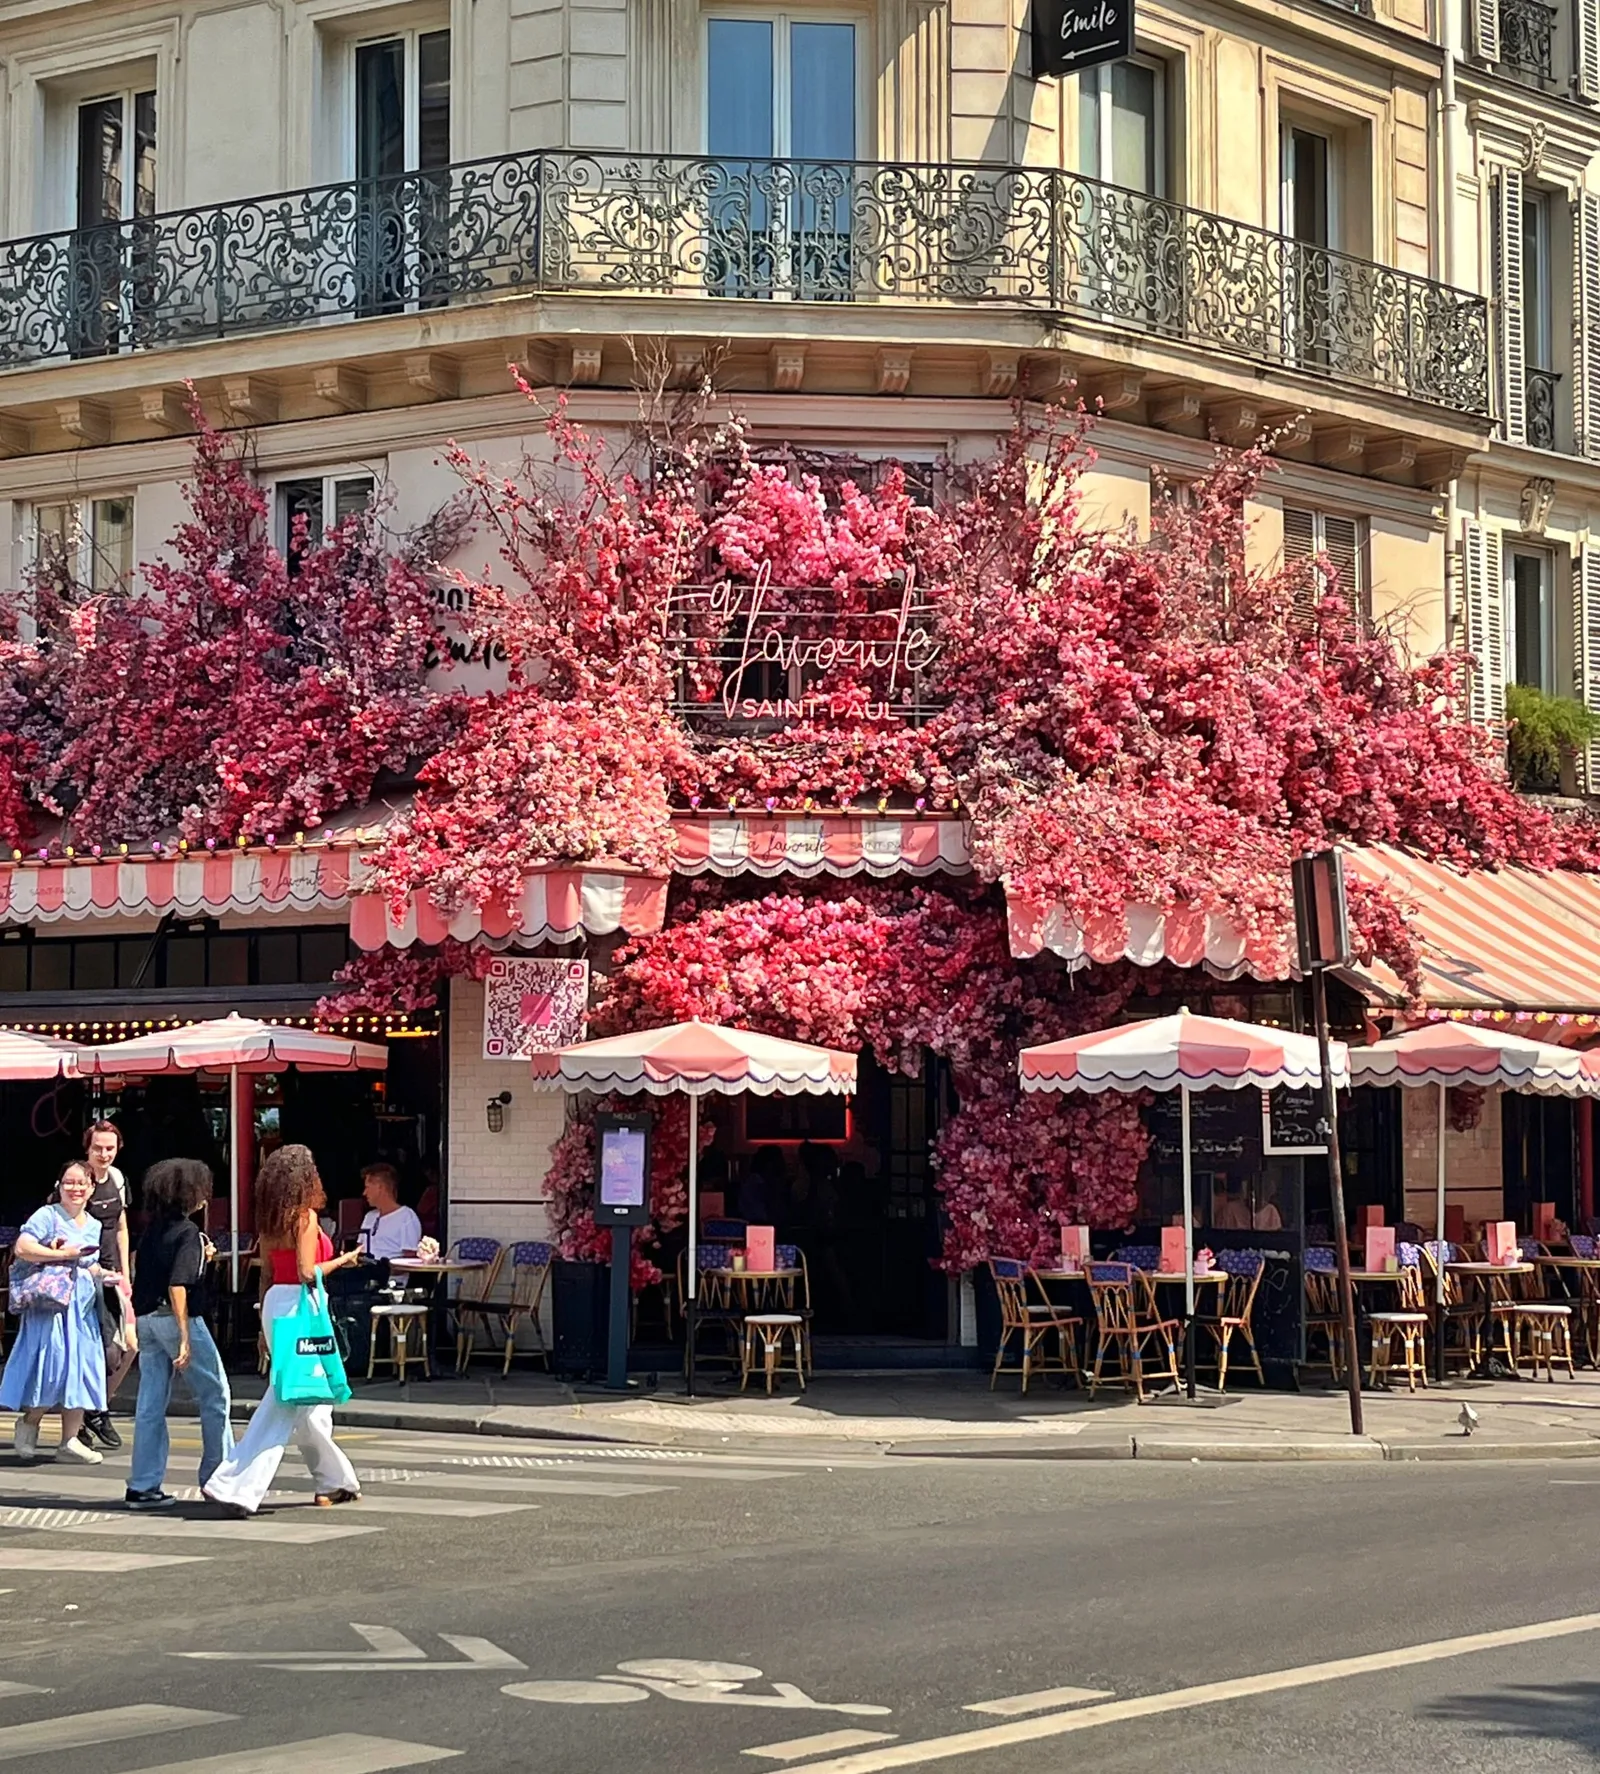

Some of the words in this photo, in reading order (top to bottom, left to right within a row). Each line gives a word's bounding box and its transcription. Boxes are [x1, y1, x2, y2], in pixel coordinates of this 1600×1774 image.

[1060, 1, 1118, 40] Emile
[723, 558, 941, 720] favorite
[742, 697, 900, 722] SAINT-PAUL
[728, 823, 760, 857] La
